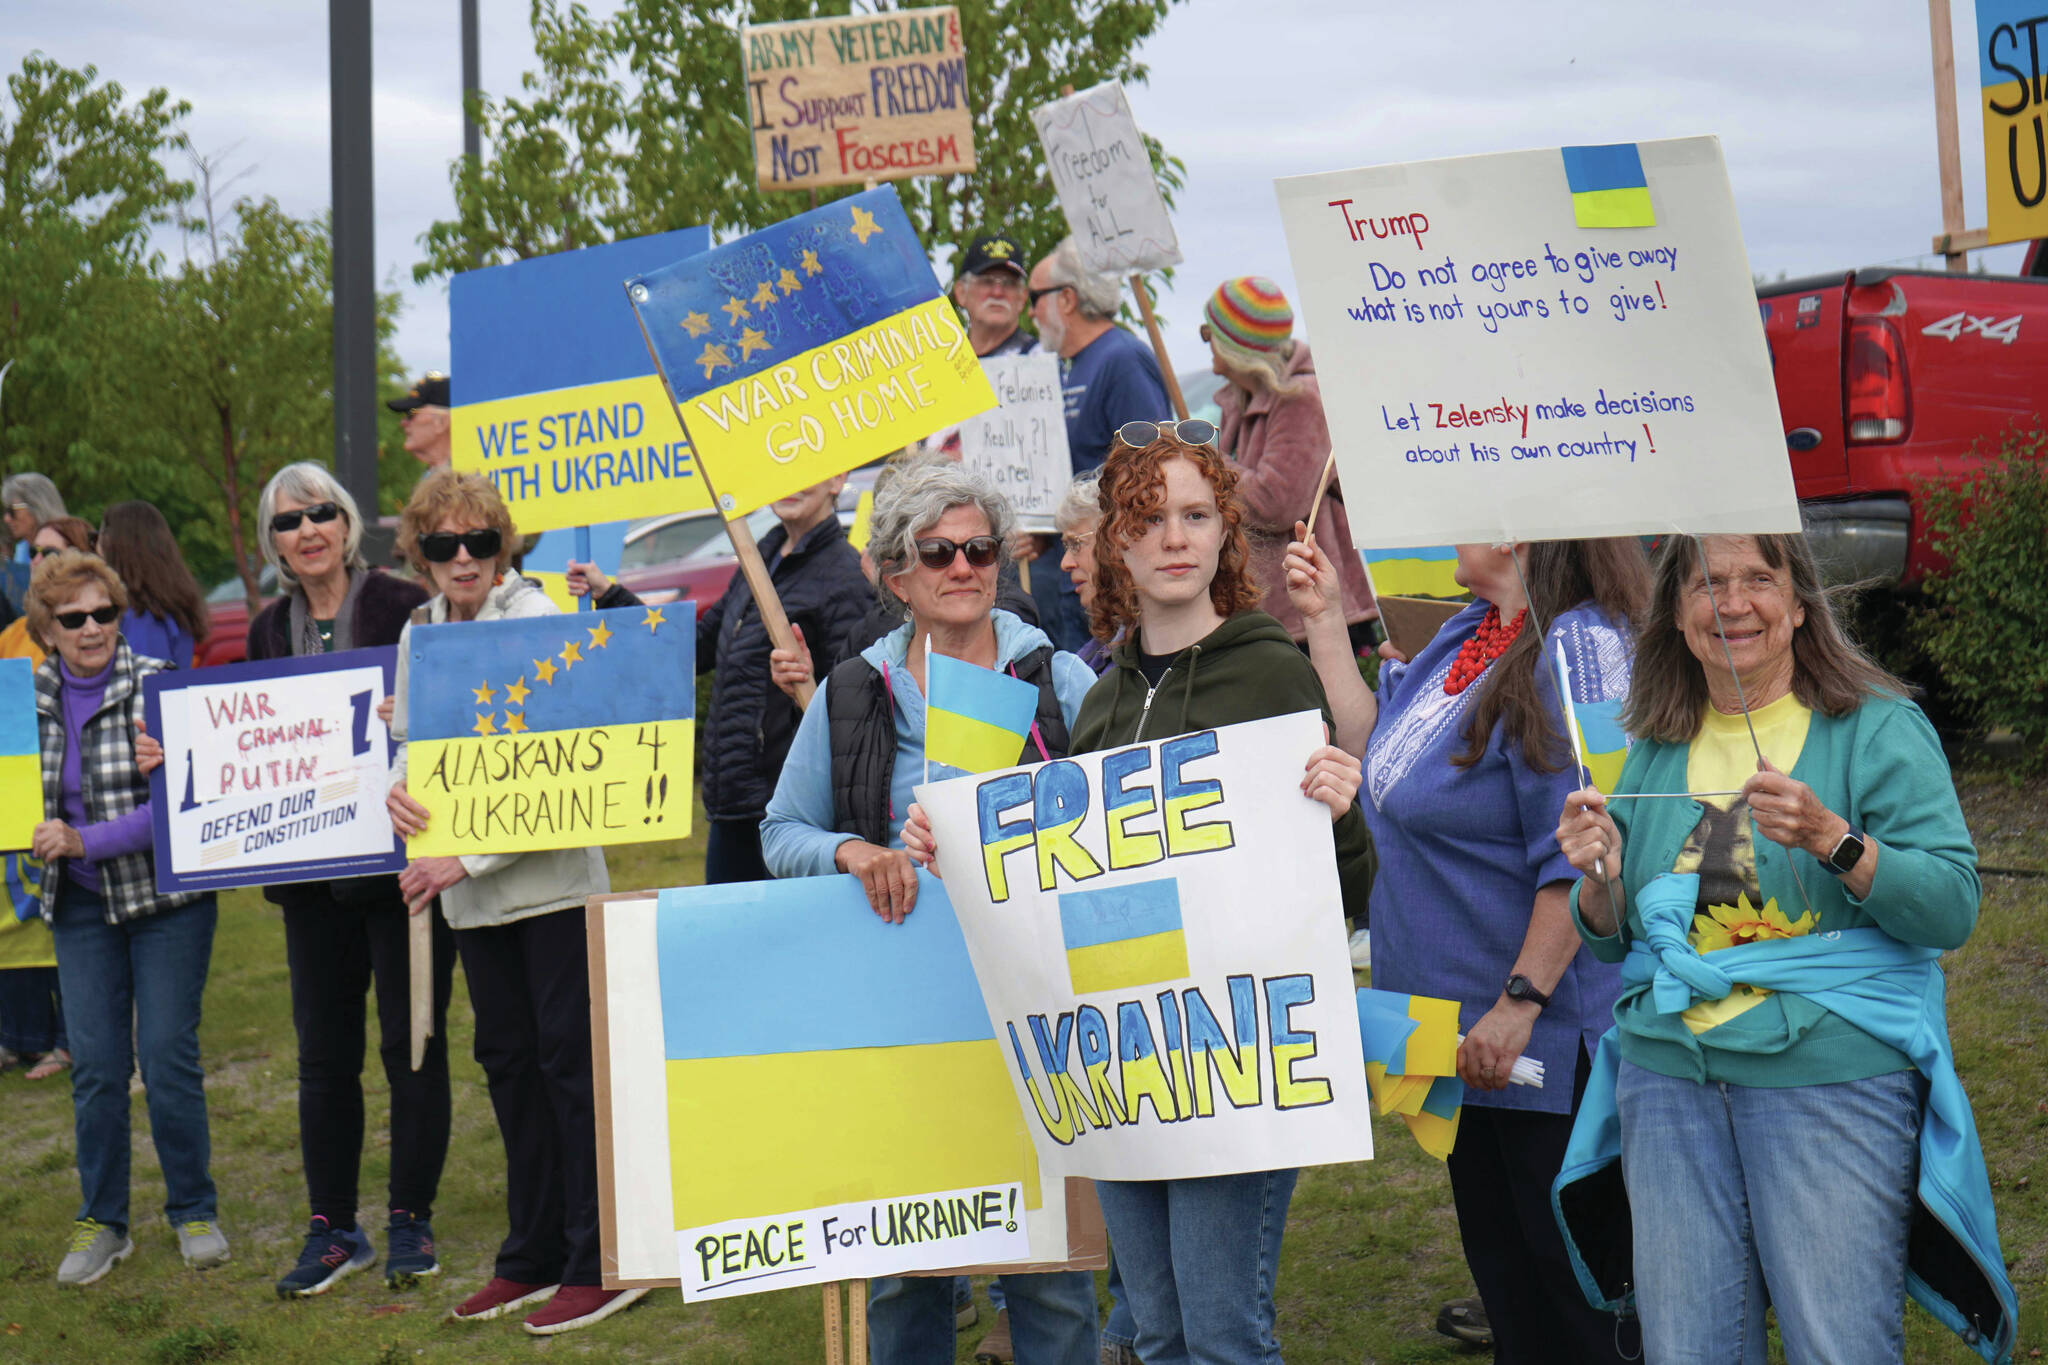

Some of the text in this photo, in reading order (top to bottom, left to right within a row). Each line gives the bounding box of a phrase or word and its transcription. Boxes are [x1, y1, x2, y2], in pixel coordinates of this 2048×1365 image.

[750, 28, 815, 71] ARMY
[828, 16, 945, 64] VETERAN
[1988, 15, 2048, 117] ST
[749, 79, 774, 130] I
[870, 58, 970, 118] FREEDOM
[2008, 113, 2048, 209] U
[1328, 198, 1429, 250] Trump
[1369, 243, 1677, 292] Do not agree to give away
[1347, 280, 1668, 333] what is not yours to give!
[697, 365, 808, 432] WAR
[811, 303, 963, 391] CRIMINALS
[477, 402, 644, 459] WE STAND
[766, 414, 825, 465] GO
[830, 364, 936, 438] HOME
[1382, 388, 1695, 439] Let Zelensky make decisions
[483, 441, 693, 502] ITH UKRAINE
[1406, 443, 1460, 463] about
[1470, 442, 1500, 462] his
[1511, 443, 1551, 460] own
[205, 692, 275, 729] WAR
[220, 755, 318, 795] PUTIN
[424, 724, 667, 793] ALASKANS 4
[200, 789, 316, 844] DEFEND OUR
[244, 801, 357, 853] CONSTITUTION
[976, 730, 1236, 904] FREE
[1006, 974, 1334, 1146] UKRAINE
[695, 1222, 805, 1282] PEACE
